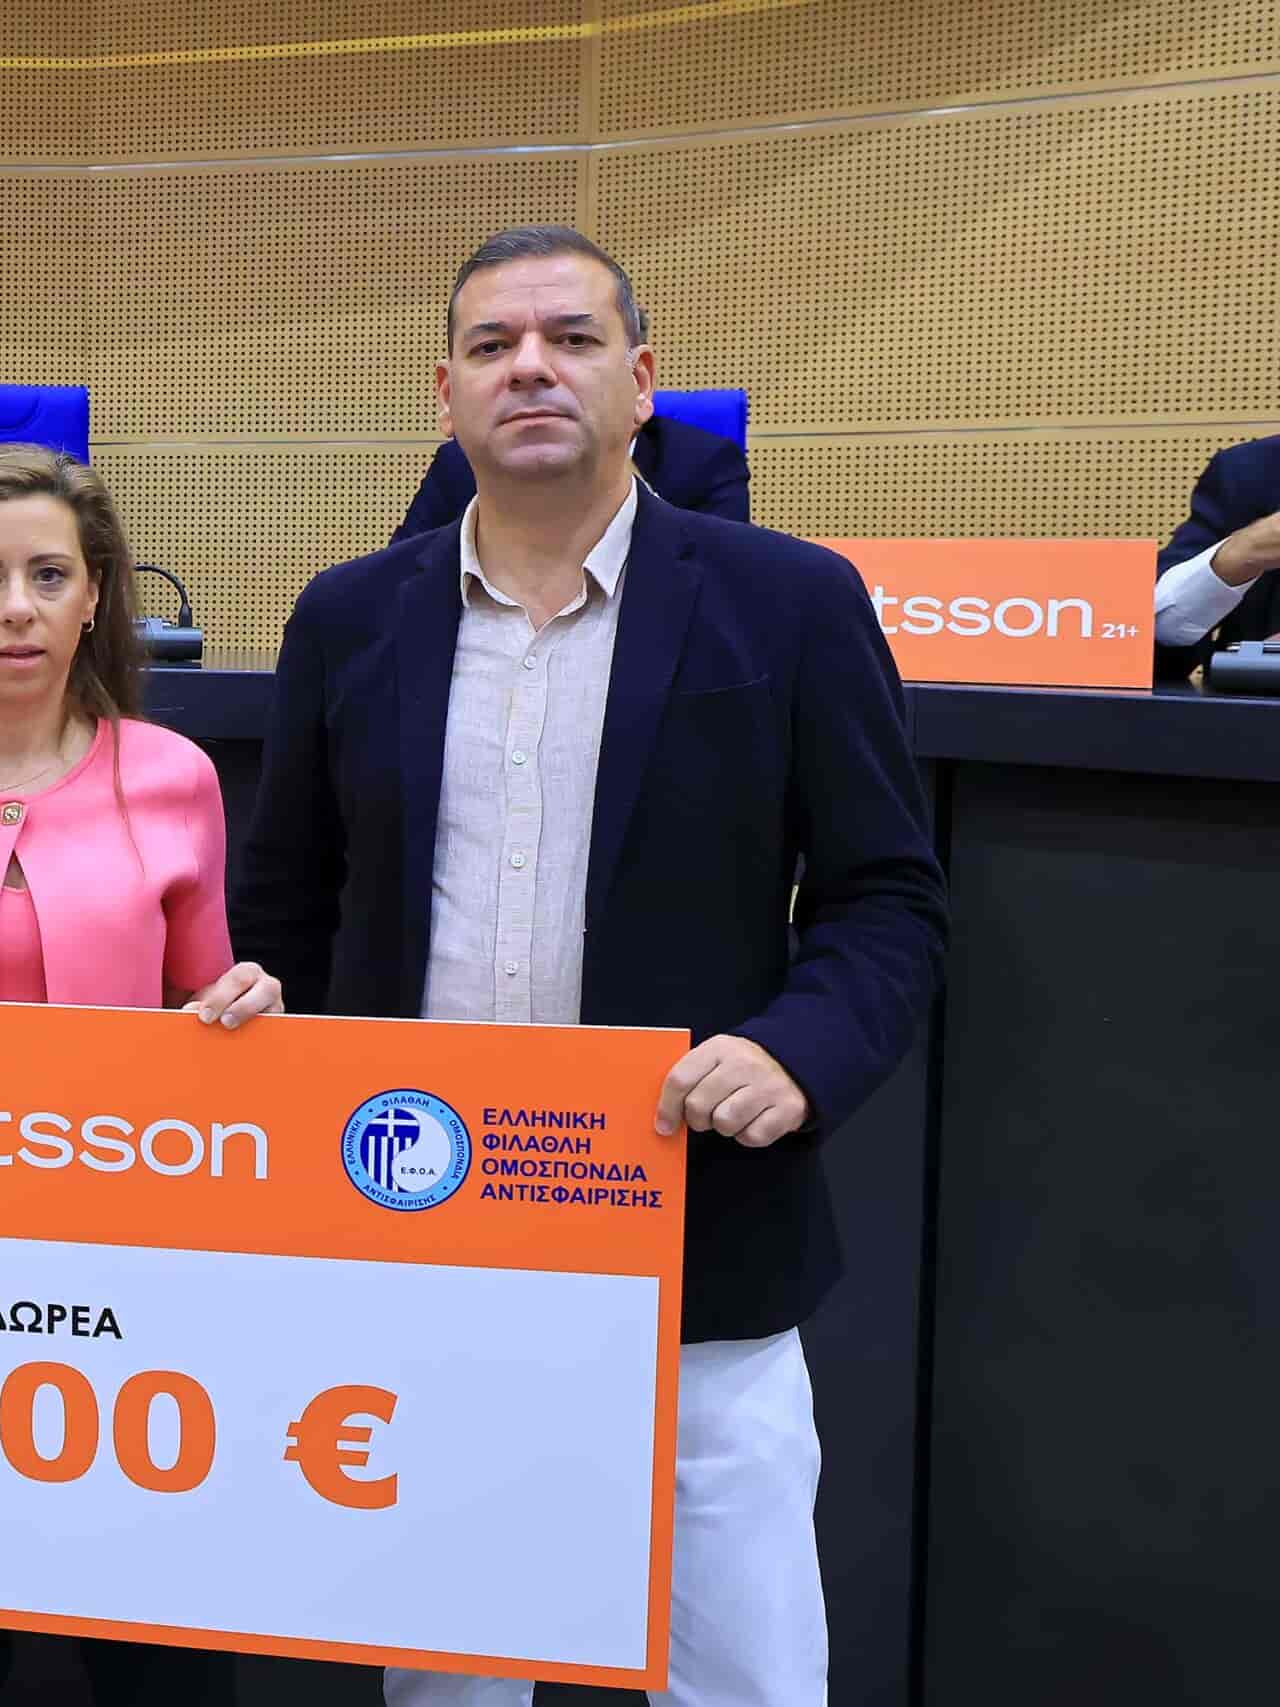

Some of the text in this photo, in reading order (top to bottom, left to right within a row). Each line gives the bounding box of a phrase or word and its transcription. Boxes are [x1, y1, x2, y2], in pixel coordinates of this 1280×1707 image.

[1100, 623, 1139, 639] 21+
[483, 1108, 606, 1130] ΕΛΛΗΝΙΚΗ
[345, 1119, 362, 1165] ΕΛΛΗΝΙΚΗ
[482, 1133, 591, 1154] ΦΙΛΑΘΛΗ
[481, 1158, 647, 1182] ΟΜΟΣΠΟΝΔΙΑ
[480, 1183, 663, 1208] ΑΝΤΙΣΦΑΙΡΙΣΗΣ
[283, 1384, 399, 1510] €
